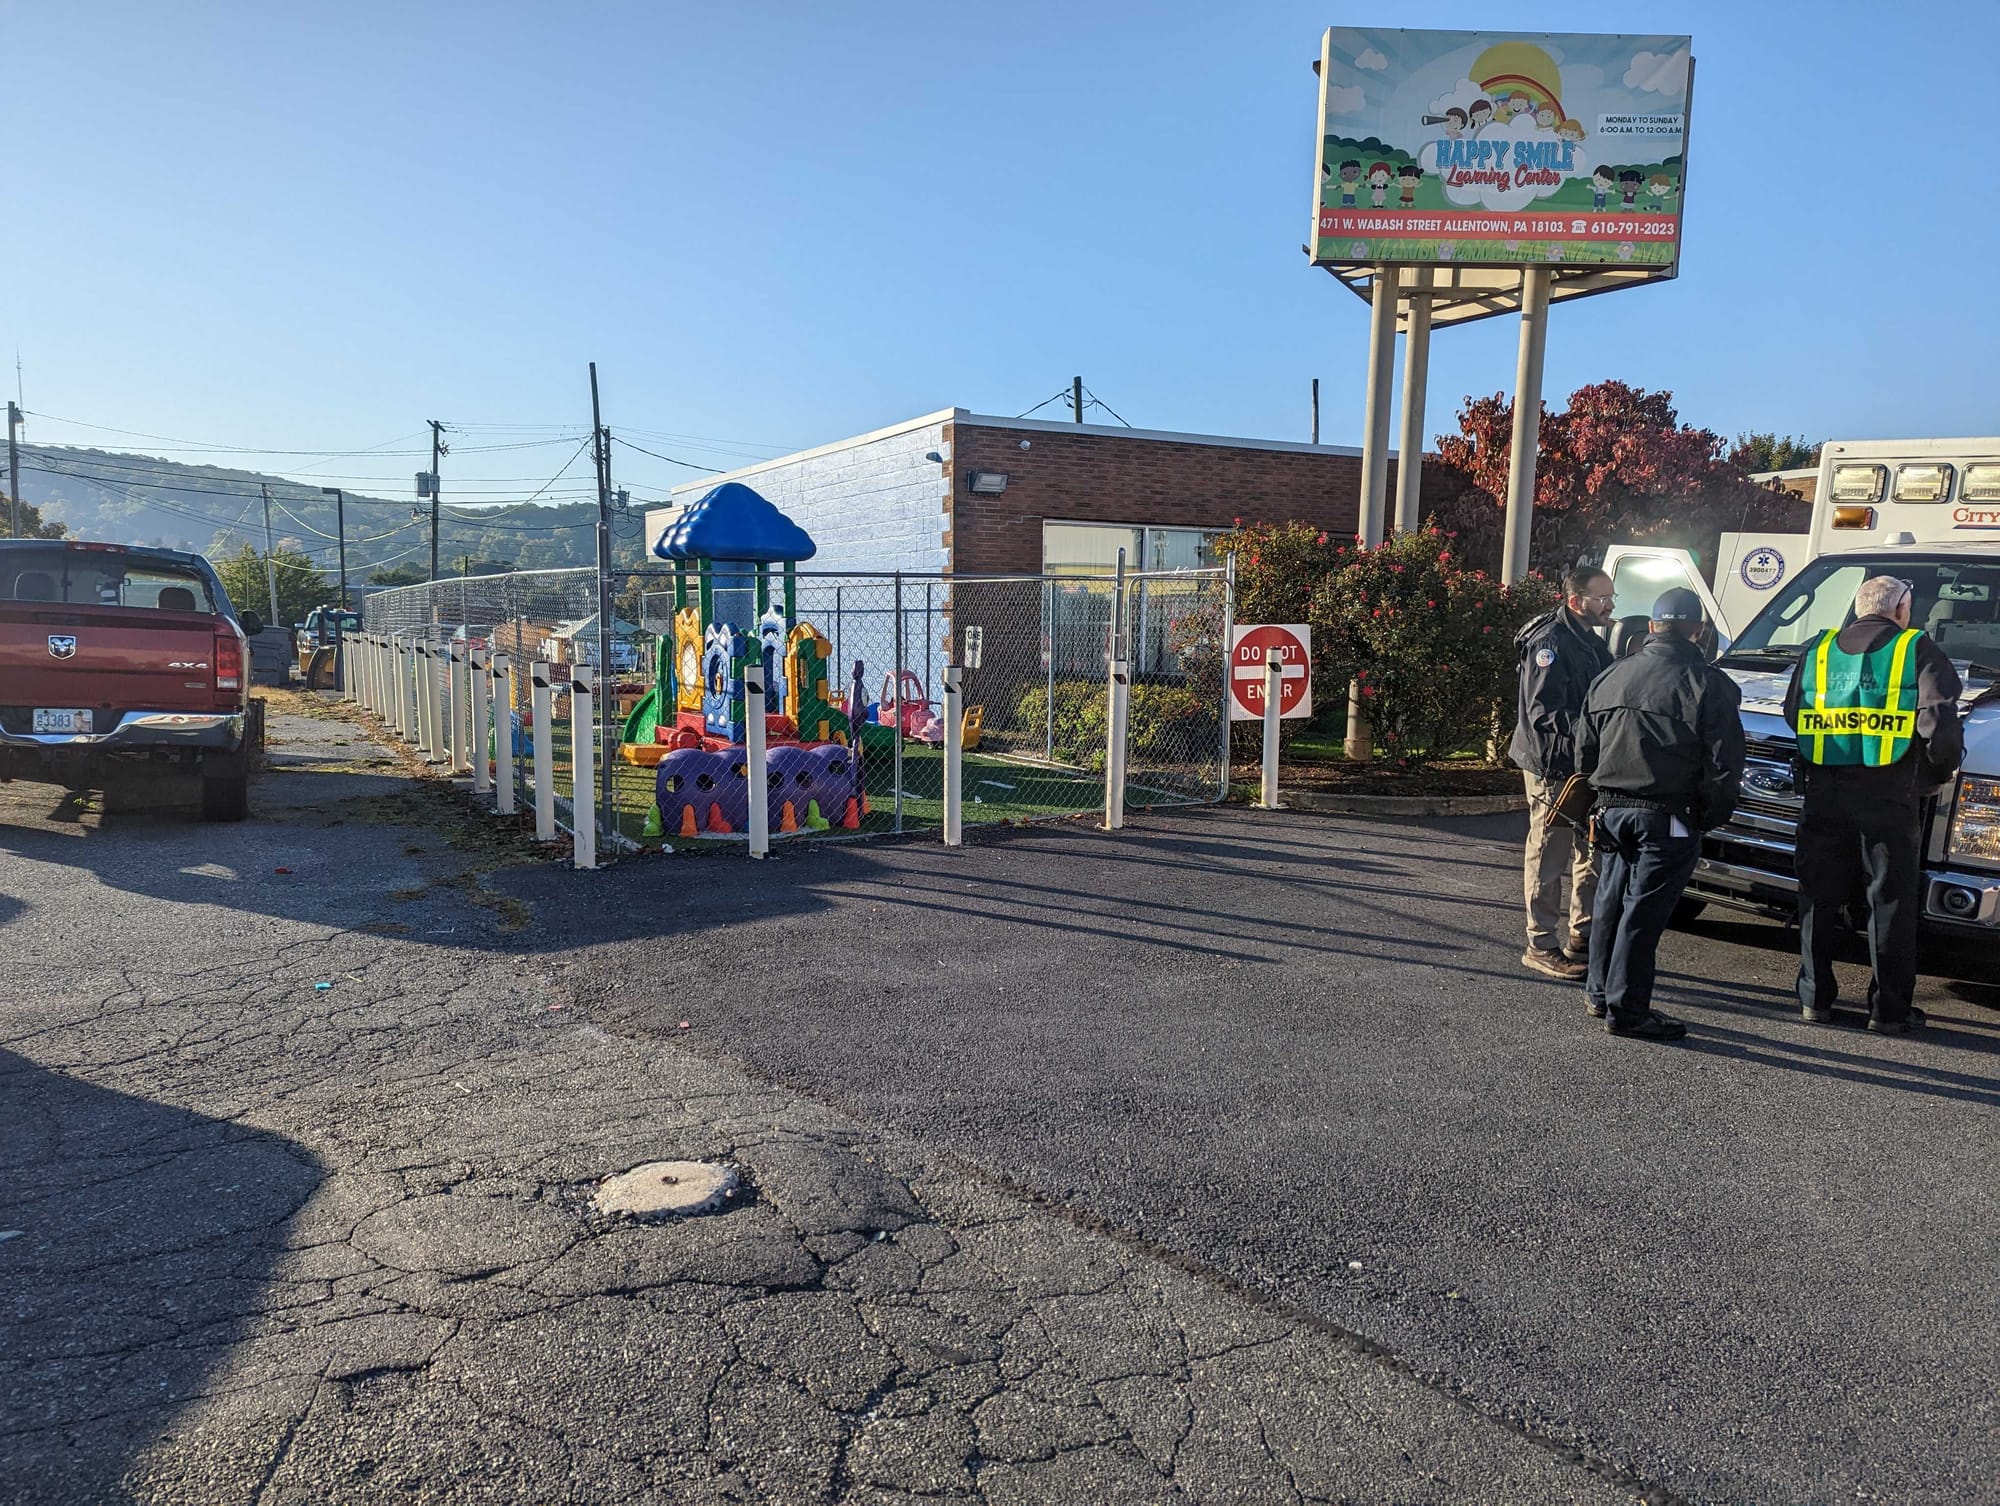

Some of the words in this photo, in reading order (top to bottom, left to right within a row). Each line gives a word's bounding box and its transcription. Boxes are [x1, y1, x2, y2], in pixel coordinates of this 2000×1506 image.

[1435, 139, 1510, 169] HAPPY
[1513, 140, 1575, 171] SMILE
[1446, 163, 1511, 192] Learning
[1514, 163, 1561, 187] Center
[1320, 217, 1338, 229] 471
[1342, 218, 1355, 230] W.
[1357, 218, 1404, 231] WABASH
[1406, 219, 1442, 231] STREET
[1444, 220, 1511, 234] ALLENTOWN,
[1513, 220, 1527, 232] PA
[1531, 221, 1566, 233] 18103.
[1591, 221, 1675, 235] 610-791-2023
[1241, 646, 1260, 660] DO
[1247, 683, 1293, 699] ENR
[1803, 712, 1908, 732] TRANSPORT
